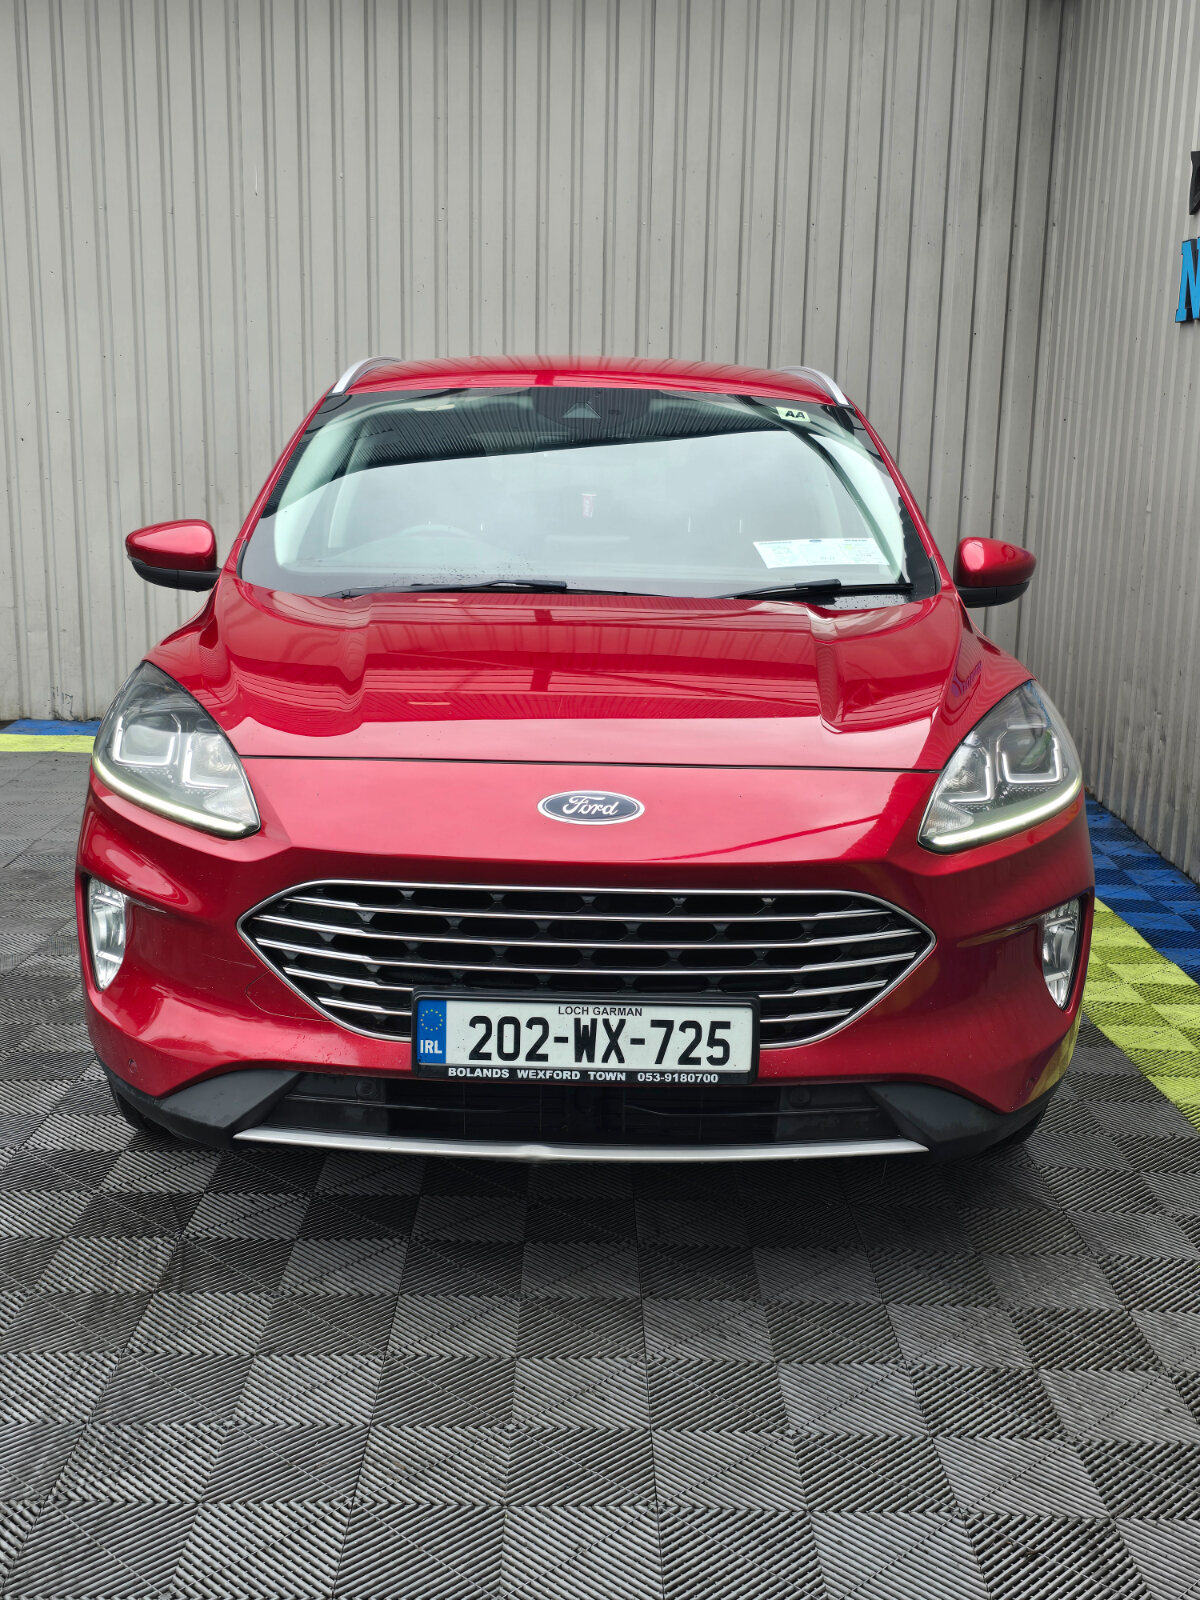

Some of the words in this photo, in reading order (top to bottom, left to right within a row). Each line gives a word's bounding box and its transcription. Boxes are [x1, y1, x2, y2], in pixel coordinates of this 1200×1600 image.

[785, 410, 806, 419] AA
[562, 795, 620, 816] Ford
[558, 1005, 589, 1016] LOCH
[592, 1006, 643, 1017] GARMAN
[420, 1039, 443, 1054] IRL
[468, 1015, 731, 1066] 202-WX-725
[448, 1067, 510, 1079] BOLANDS
[516, 1069, 581, 1080] WEXFORD
[587, 1071, 626, 1081] TOWN
[637, 1072, 719, 1083] 053-9180700
